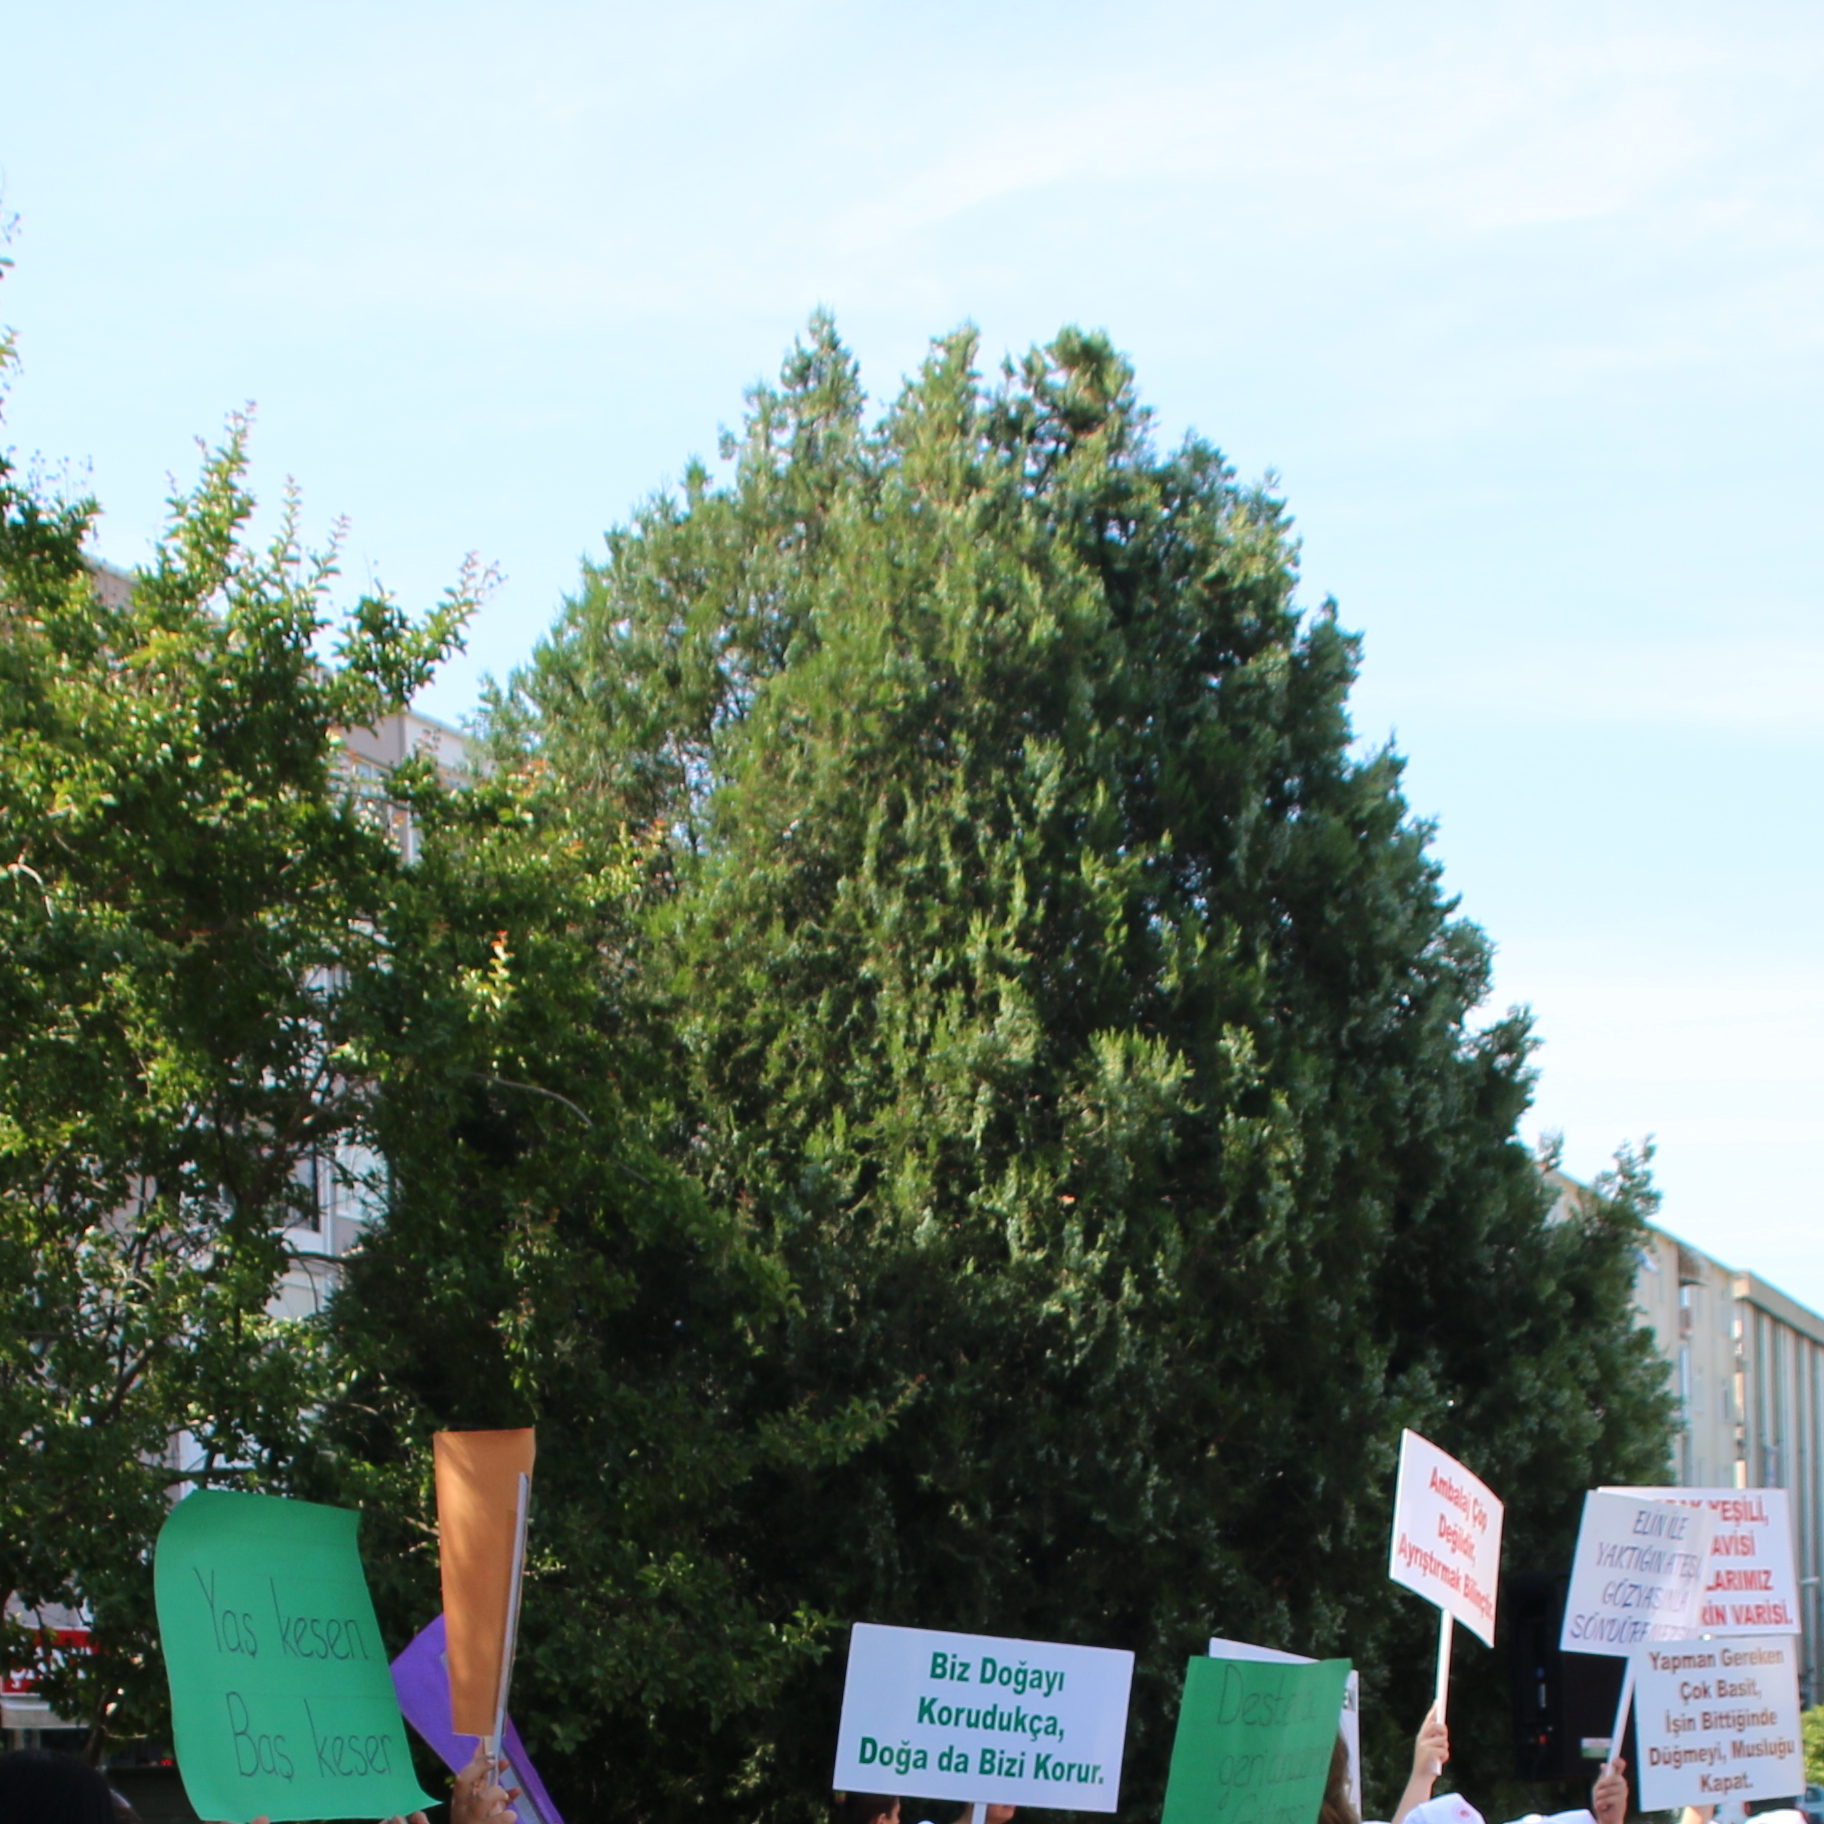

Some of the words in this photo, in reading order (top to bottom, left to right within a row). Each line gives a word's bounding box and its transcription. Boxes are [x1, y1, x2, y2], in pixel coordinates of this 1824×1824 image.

[1430, 1466, 1472, 1520] Ambalaj
[1711, 1530, 1756, 1556] AVİSİ
[270, 1577, 368, 1661] kesen
[930, 1651, 970, 1682] Biz
[979, 1656, 1066, 1698] Doğayı
[1649, 1651, 1716, 1674] Yapman
[1721, 1648, 1784, 1667] Gereken
[1680, 1681, 1713, 1706] Çok
[1717, 1678, 1762, 1699] Basit,
[304, 1698, 392, 1778] keser
[917, 1696, 1065, 1742] Korudukça,
[1666, 1709, 1696, 1738] İşin
[1702, 1708, 1778, 1733] Bittiğinde
[858, 1737, 928, 1775] Doğa
[937, 1745, 969, 1773] da
[979, 1748, 1026, 1779] Bizi
[1033, 1752, 1105, 1785] Korur.
[1649, 1742, 1727, 1769] Düğmeyi,
[1732, 1736, 1795, 1760] Musluğu
[1700, 1772, 1754, 1796] Kapat.
